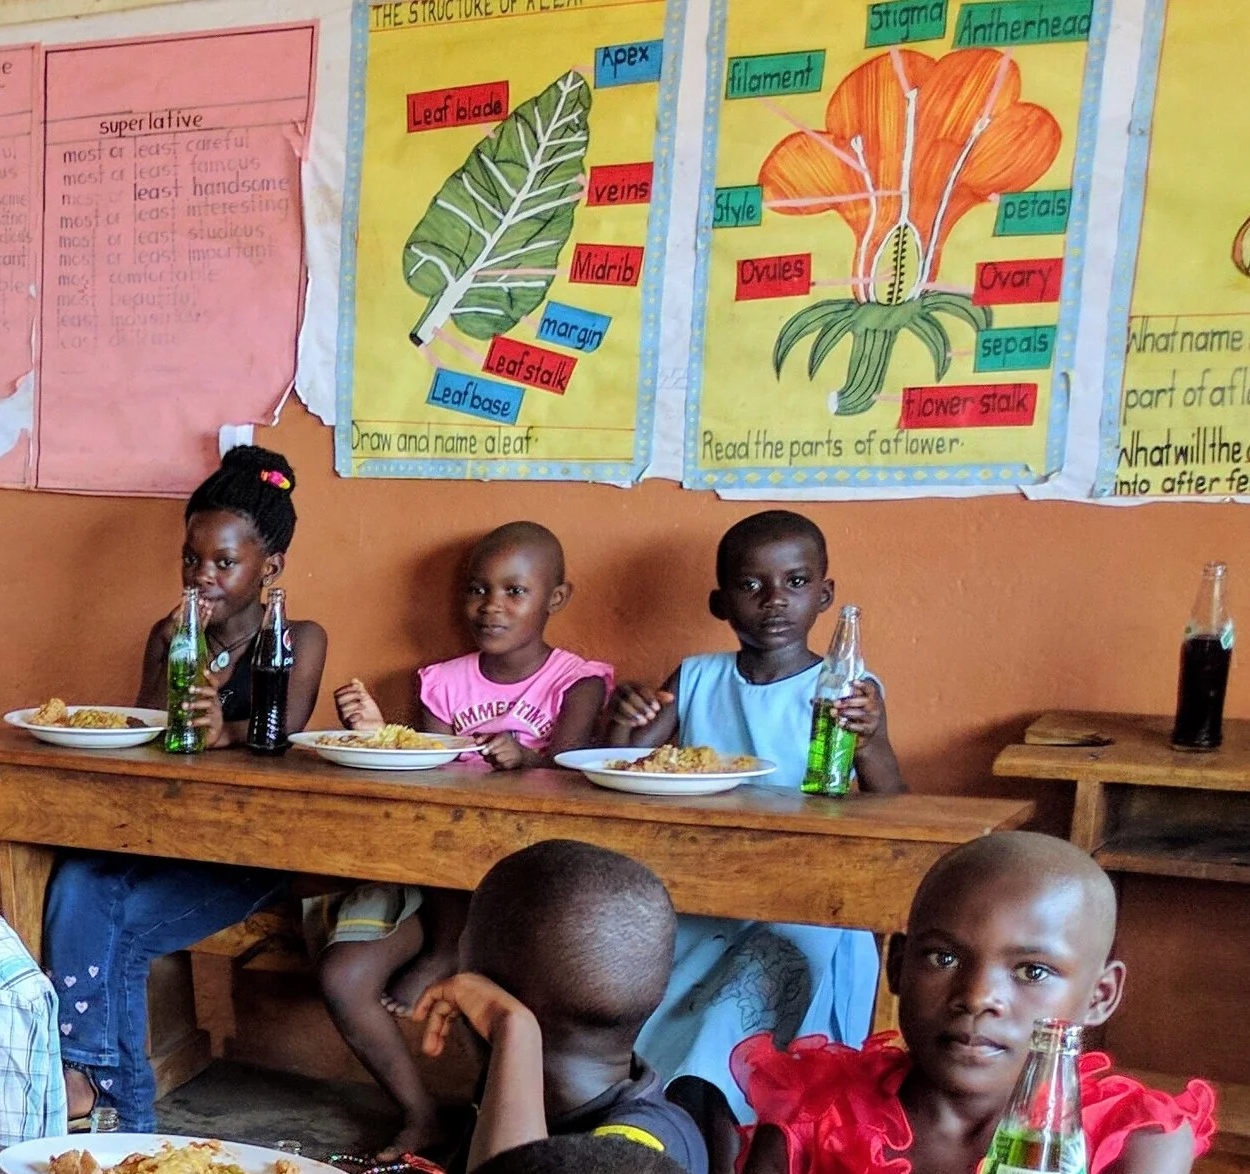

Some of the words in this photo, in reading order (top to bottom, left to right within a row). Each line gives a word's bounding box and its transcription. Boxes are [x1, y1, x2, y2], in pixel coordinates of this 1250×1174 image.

[372, 4, 403, 27] THE
[408, 0, 493, 23] STRUCTURE
[870, 1, 943, 41] Stigma
[602, 46, 650, 78] Apex
[729, 56, 812, 94] filament
[100, 111, 203, 137] superlative
[412, 95, 450, 126] Leaf
[456, 97, 503, 121] blade
[134, 178, 182, 201] least
[595, 179, 649, 202] veins
[714, 192, 755, 226] Style
[1004, 192, 1067, 231] petals
[574, 250, 635, 282] Midrib
[740, 256, 806, 284] Ovules
[979, 262, 1052, 301] Ovary
[540, 316, 603, 350] margin
[982, 327, 1049, 367] sepals
[1181, 330, 1243, 353] name
[980, 383, 1027, 414] stalk
[1124, 370, 1175, 426] part
[1183, 369, 1211, 406] of
[351, 420, 390, 450] Draw
[397, 422, 429, 452] and
[435, 434, 477, 453] name
[702, 430, 749, 462] Read
[754, 430, 784, 459] the
[789, 430, 842, 466] parts
[855, 430, 876, 455] of
[1209, 426, 1241, 463] the
[1115, 473, 1150, 496] into
[1162, 470, 1220, 494] after
